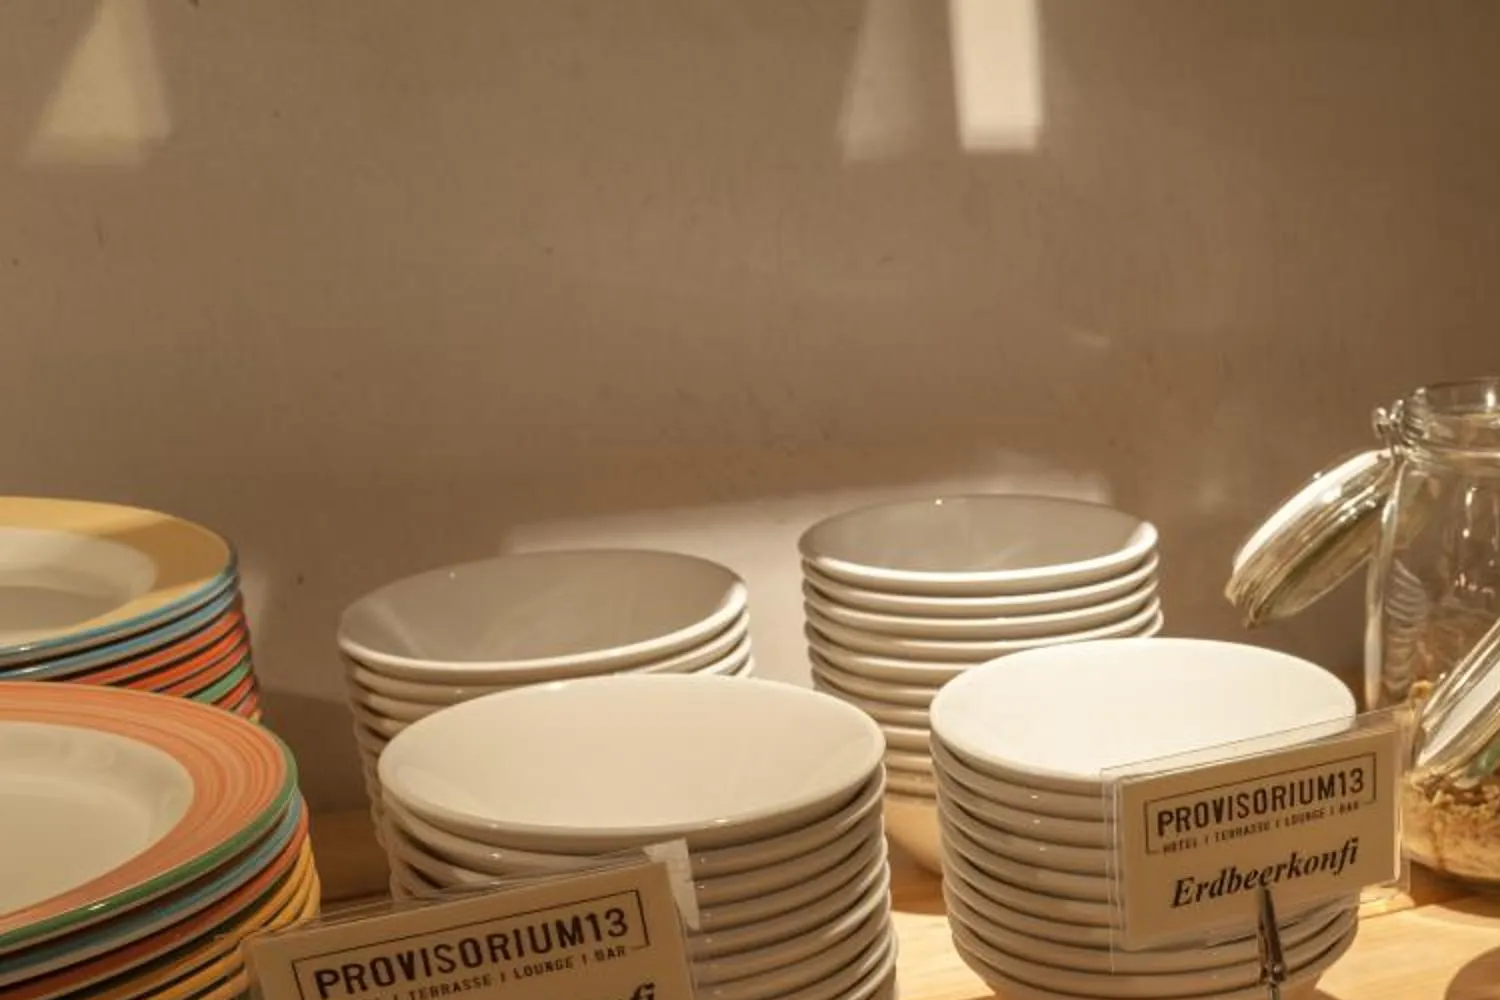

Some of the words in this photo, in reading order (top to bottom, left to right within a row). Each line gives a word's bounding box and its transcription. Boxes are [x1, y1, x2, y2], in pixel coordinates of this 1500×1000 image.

[1157, 767, 1364, 837] PROVISORIUM13
[1171, 837, 1360, 908] Erdbeerkonfi
[314, 907, 629, 1000] PROVISORIUM13
[513, 956, 575, 980] LOUNGE
[596, 944, 627, 961] BAR
